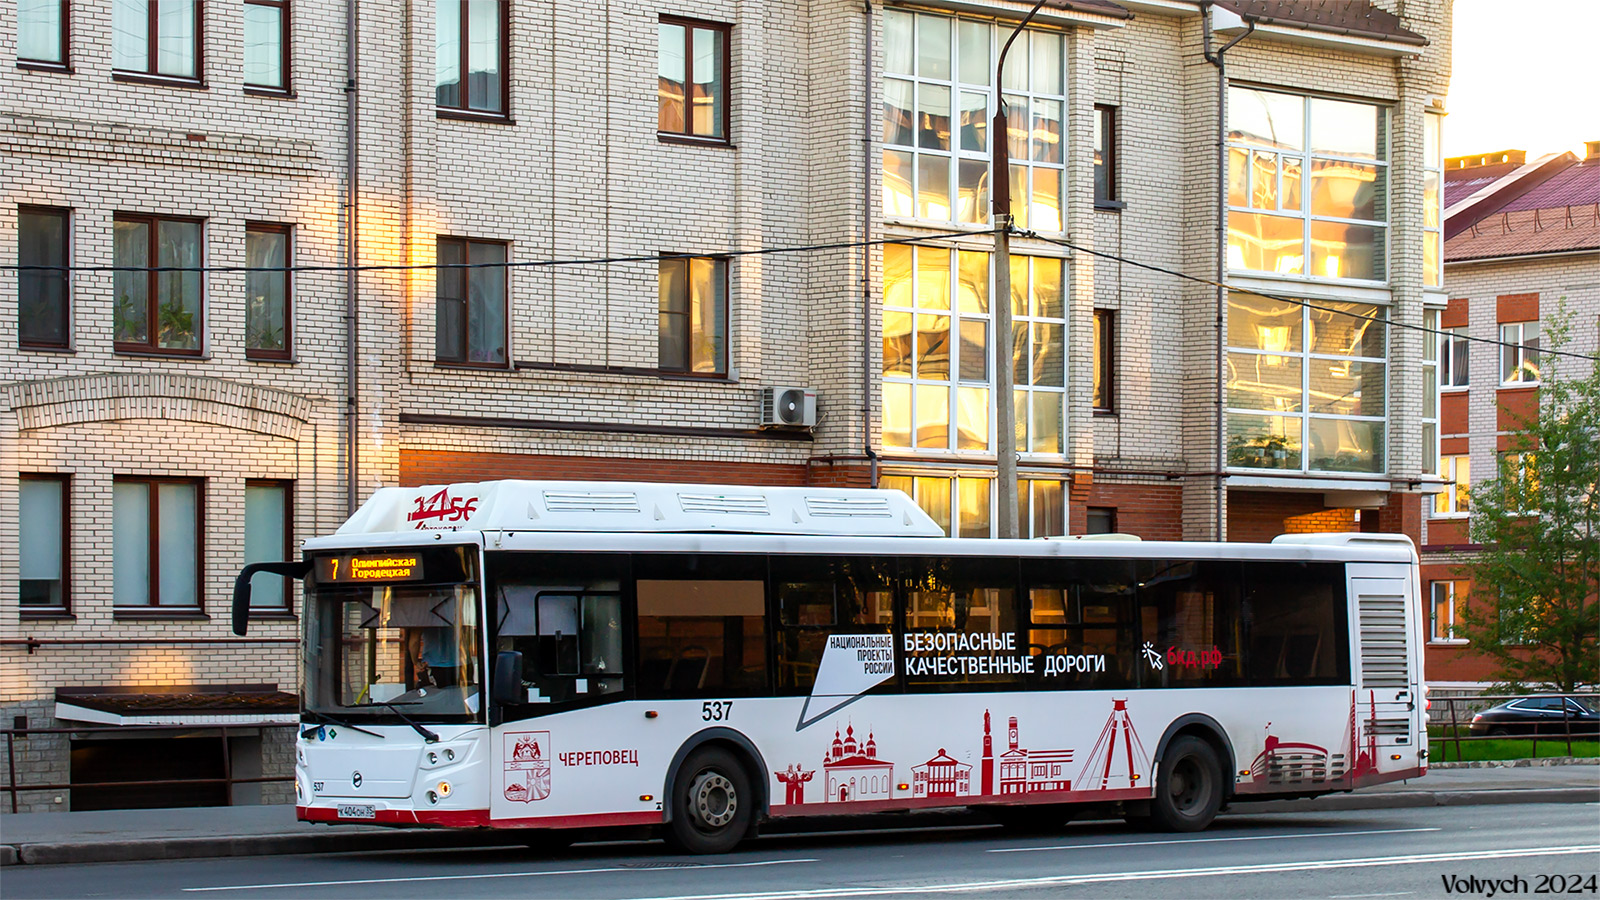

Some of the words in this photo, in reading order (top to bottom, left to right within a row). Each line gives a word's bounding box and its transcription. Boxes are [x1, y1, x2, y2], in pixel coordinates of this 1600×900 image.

[331, 559, 339, 580] 7
[351, 558, 416, 568] Олимпийская
[351, 568, 410, 578] Городецкая
[830, 636, 892, 649] НАЦИОНАЛЬНЫЕ
[904, 632, 1016, 652] БЕЗОПАСНЫЕ
[857, 649, 893, 661] ПРОЕКТЫ
[1167, 645, 1223, 670] бкд.рф
[864, 661, 893, 675] РОССИИ
[905, 655, 1034, 676] КАЧЕСТВЕННЫЕ
[1044, 654, 1106, 677] ДОРОГИ
[701, 701, 733, 722] 537
[558, 749, 639, 767] ЧЕРЕПОВЕЦ
[313, 782, 324, 792] 537
